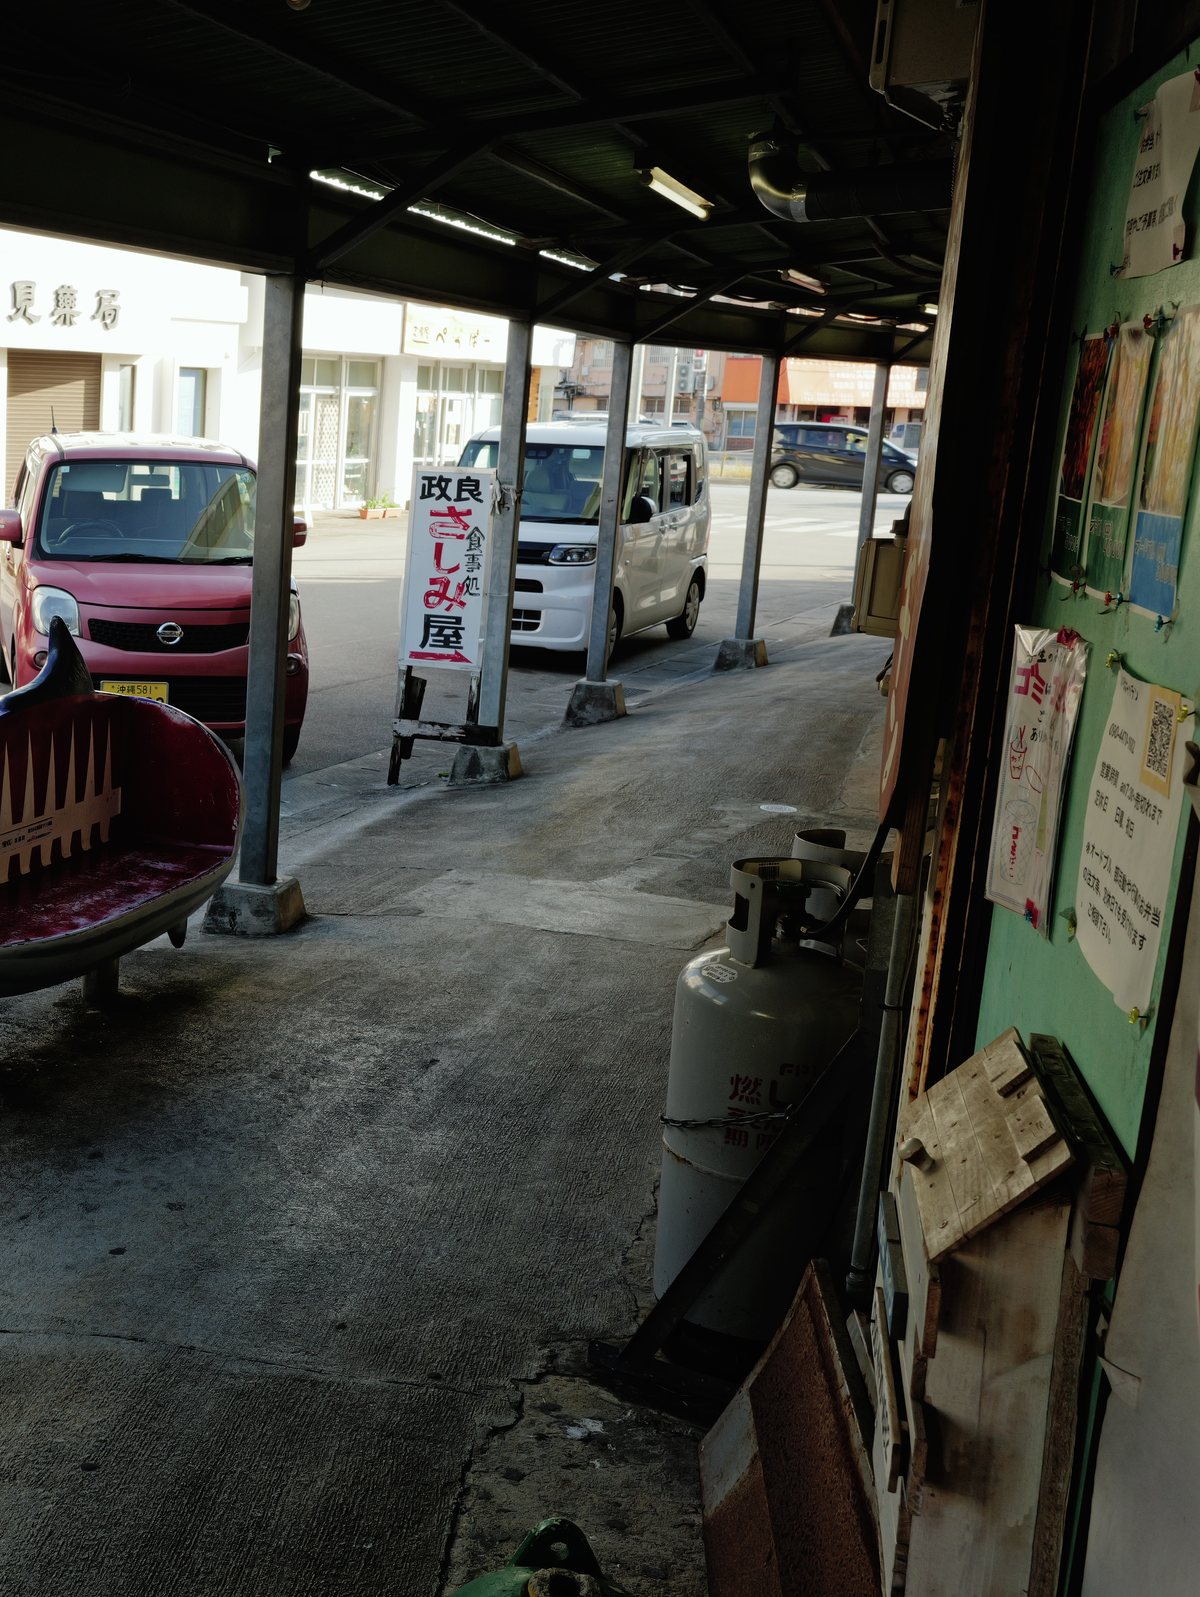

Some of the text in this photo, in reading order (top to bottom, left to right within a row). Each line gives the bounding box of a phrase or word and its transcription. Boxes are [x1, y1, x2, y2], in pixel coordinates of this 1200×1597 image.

[419, 474, 484, 503] 政良
[463, 526, 486, 597] 食事処
[729, 1073, 763, 1105] 燃
